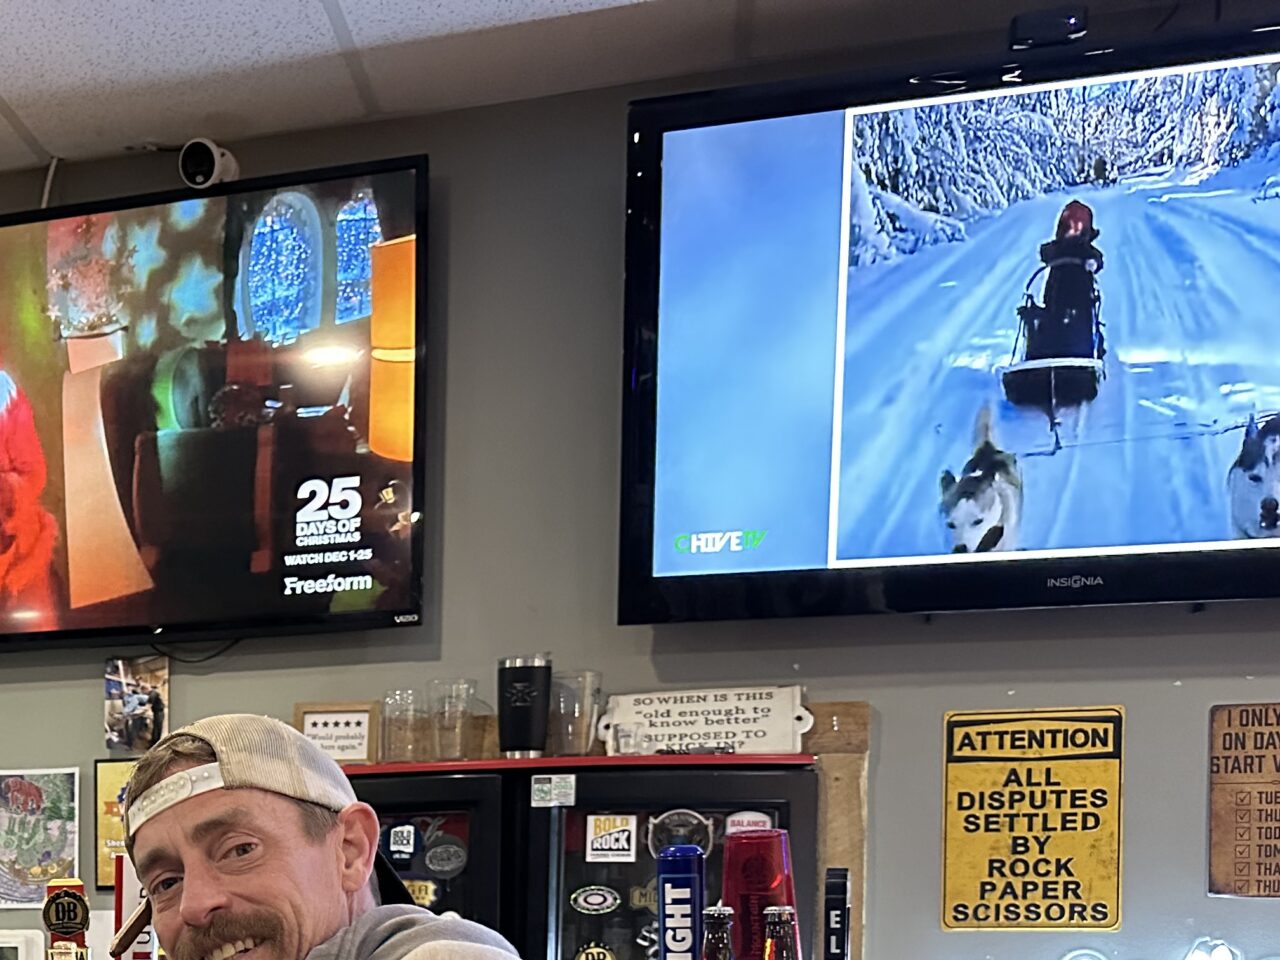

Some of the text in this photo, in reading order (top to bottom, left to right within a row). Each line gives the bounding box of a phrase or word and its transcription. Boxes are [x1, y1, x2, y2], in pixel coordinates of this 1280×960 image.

[296, 476, 362, 522] 25
[296, 518, 361, 537] DAYS OF
[296, 532, 361, 547] CHRISTMAS
[284, 549, 372, 566] WATCH DEC 1-25
[284, 574, 372, 595] Freeform
[1047, 576, 1103, 587] INSIGNIA
[633, 698, 654, 706] SO
[657, 695, 707, 704] WHEN
[734, 692, 774, 700] THIS
[678, 707, 745, 717] enough
[753, 706, 771, 714] to
[1227, 710, 1231, 727] I
[648, 719, 698, 728] know
[644, 730, 766, 743] SUPPOSED TO
[957, 728, 1108, 751] ATTENTION
[1223, 732, 1246, 750] ON
[1210, 755, 1266, 774] START
[1002, 768, 1061, 787] ALL
[957, 789, 1108, 810] DISPUTES
[594, 817, 629, 835] BOLD
[730, 819, 767, 828] BALANCE
[963, 812, 1101, 832] SETTLED
[393, 838, 411, 846] ROCK
[592, 830, 629, 850] ROCK
[1012, 835, 1051, 855] BY
[987, 857, 1074, 877] ROCK
[980, 881, 1082, 900] PAPER
[55, 902, 78, 922] DB
[952, 903, 1108, 922] SCISSORS
